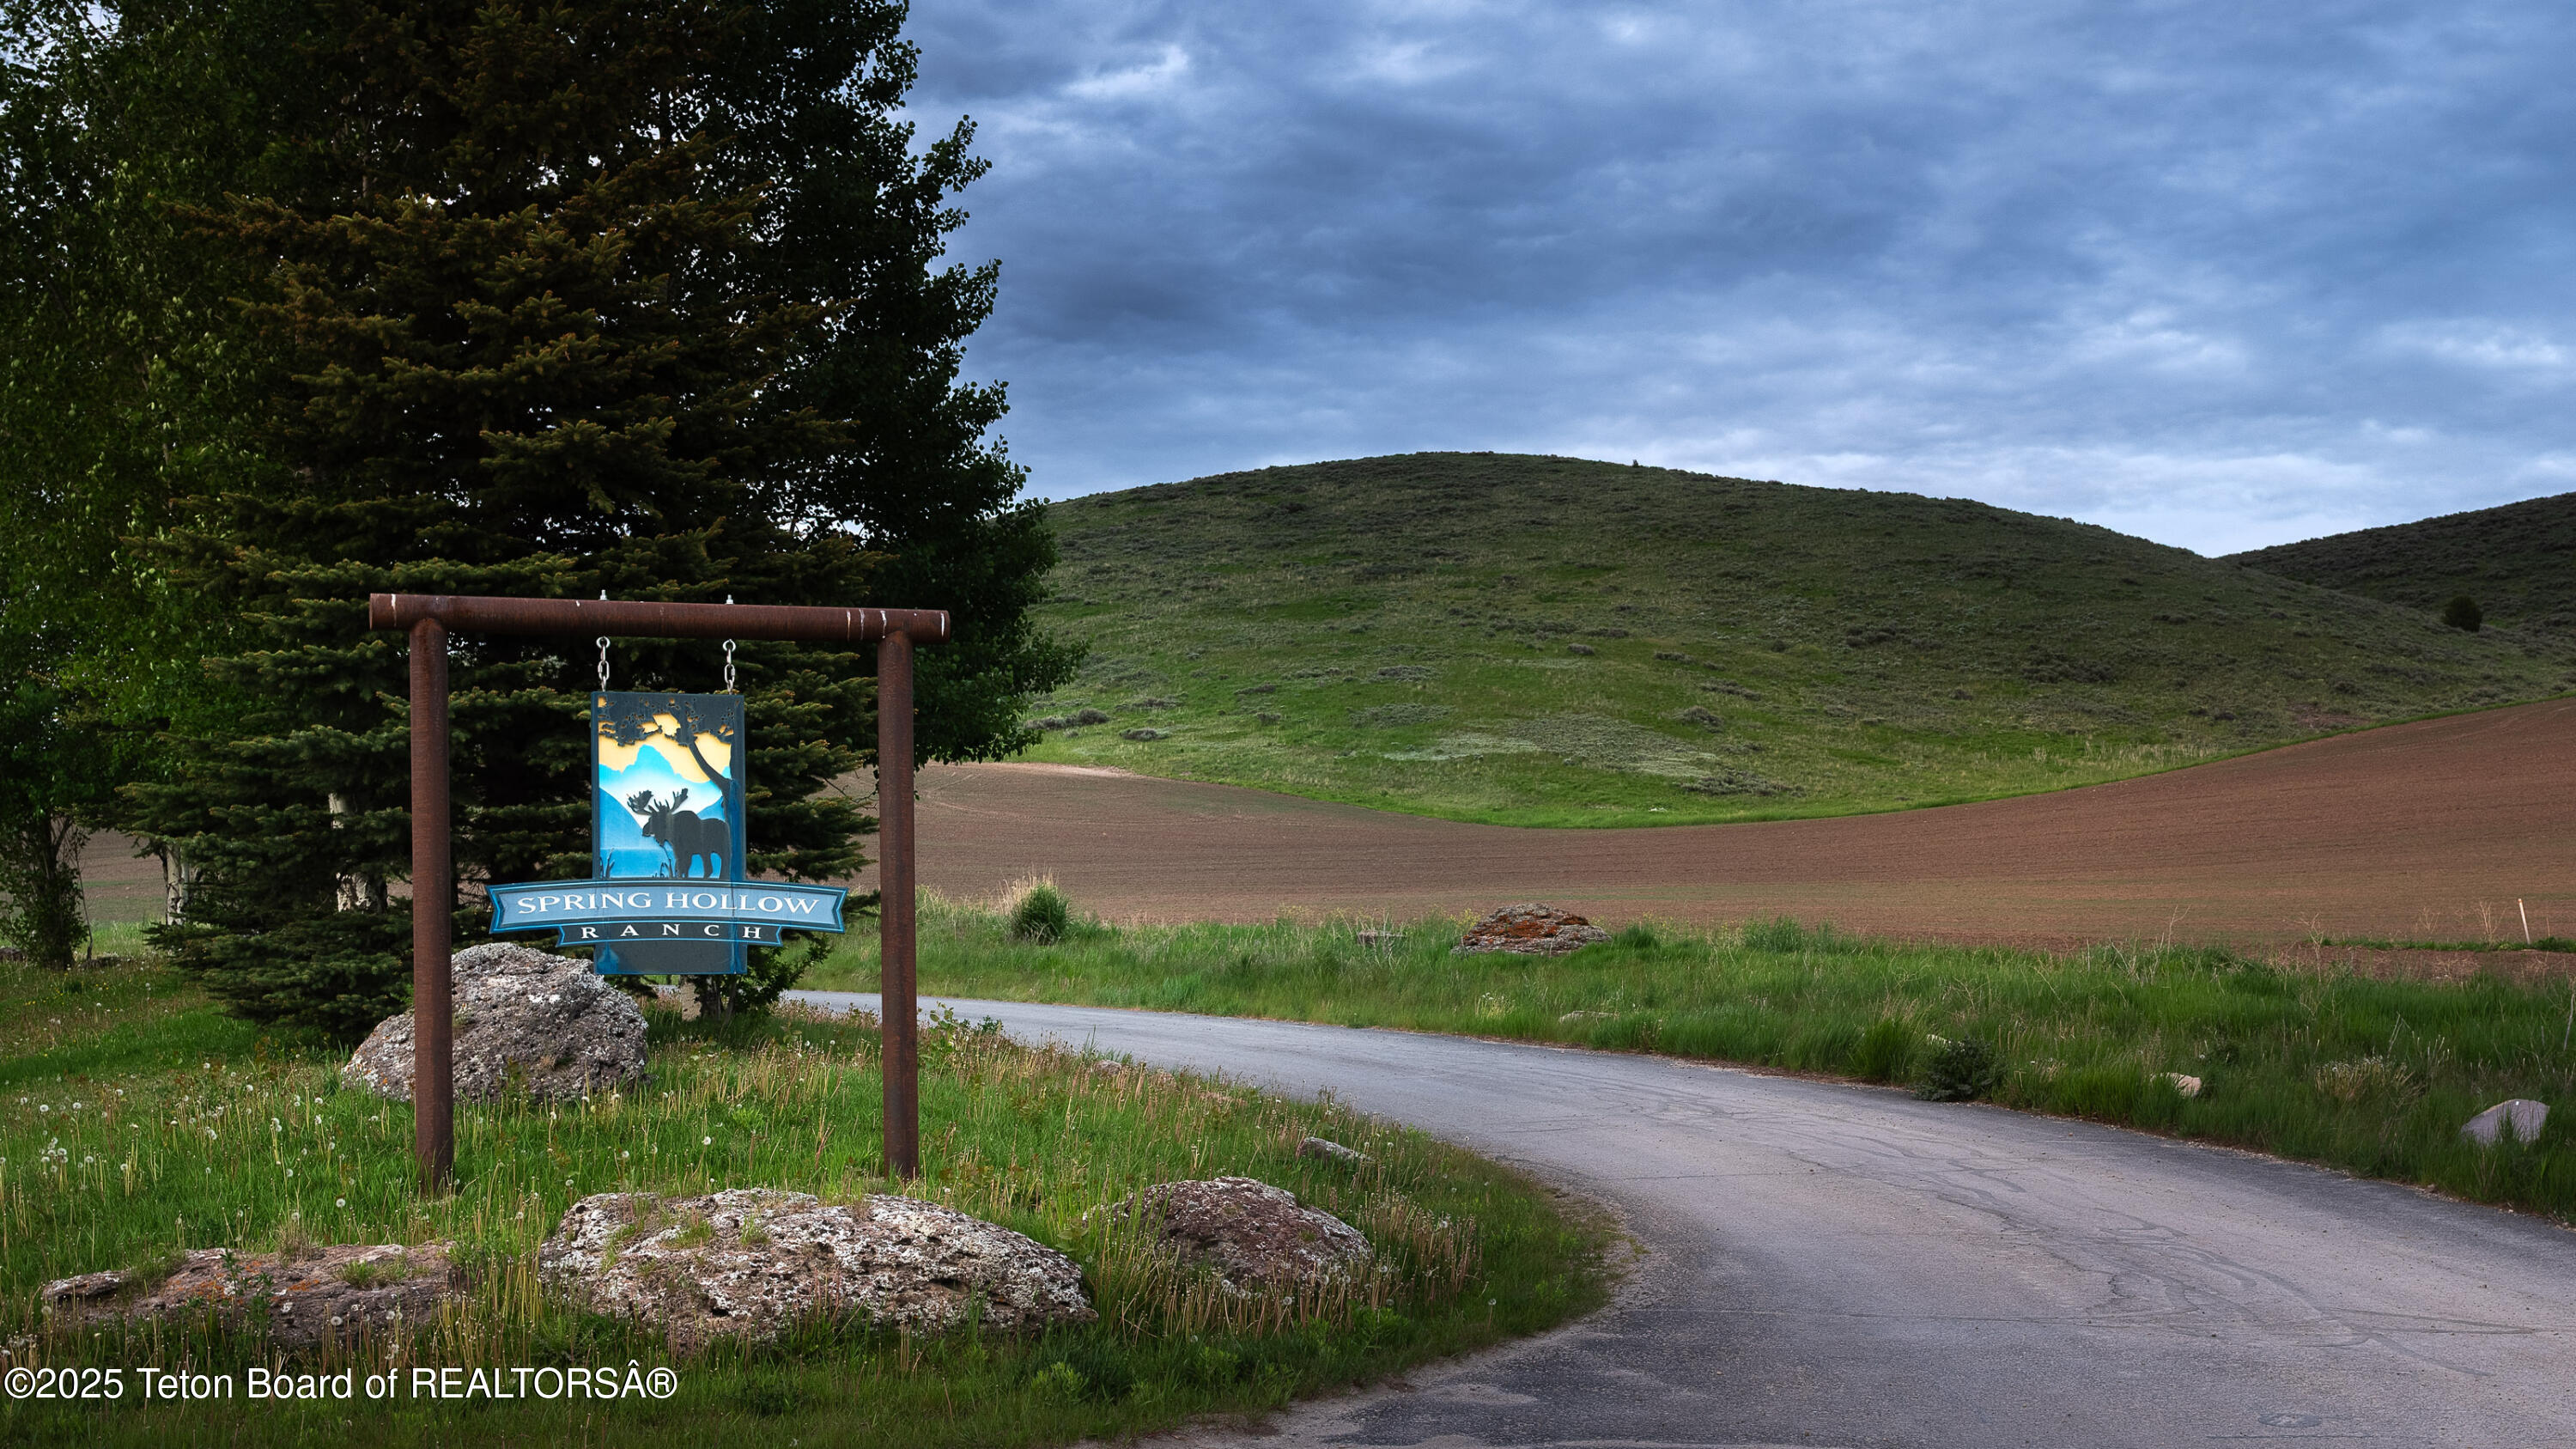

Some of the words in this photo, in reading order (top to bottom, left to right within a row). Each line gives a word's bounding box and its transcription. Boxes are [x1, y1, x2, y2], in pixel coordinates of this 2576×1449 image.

[518, 892, 653, 915] SPRING
[666, 892, 820, 915] HOLLOW
[580, 923, 762, 940] RANCH
